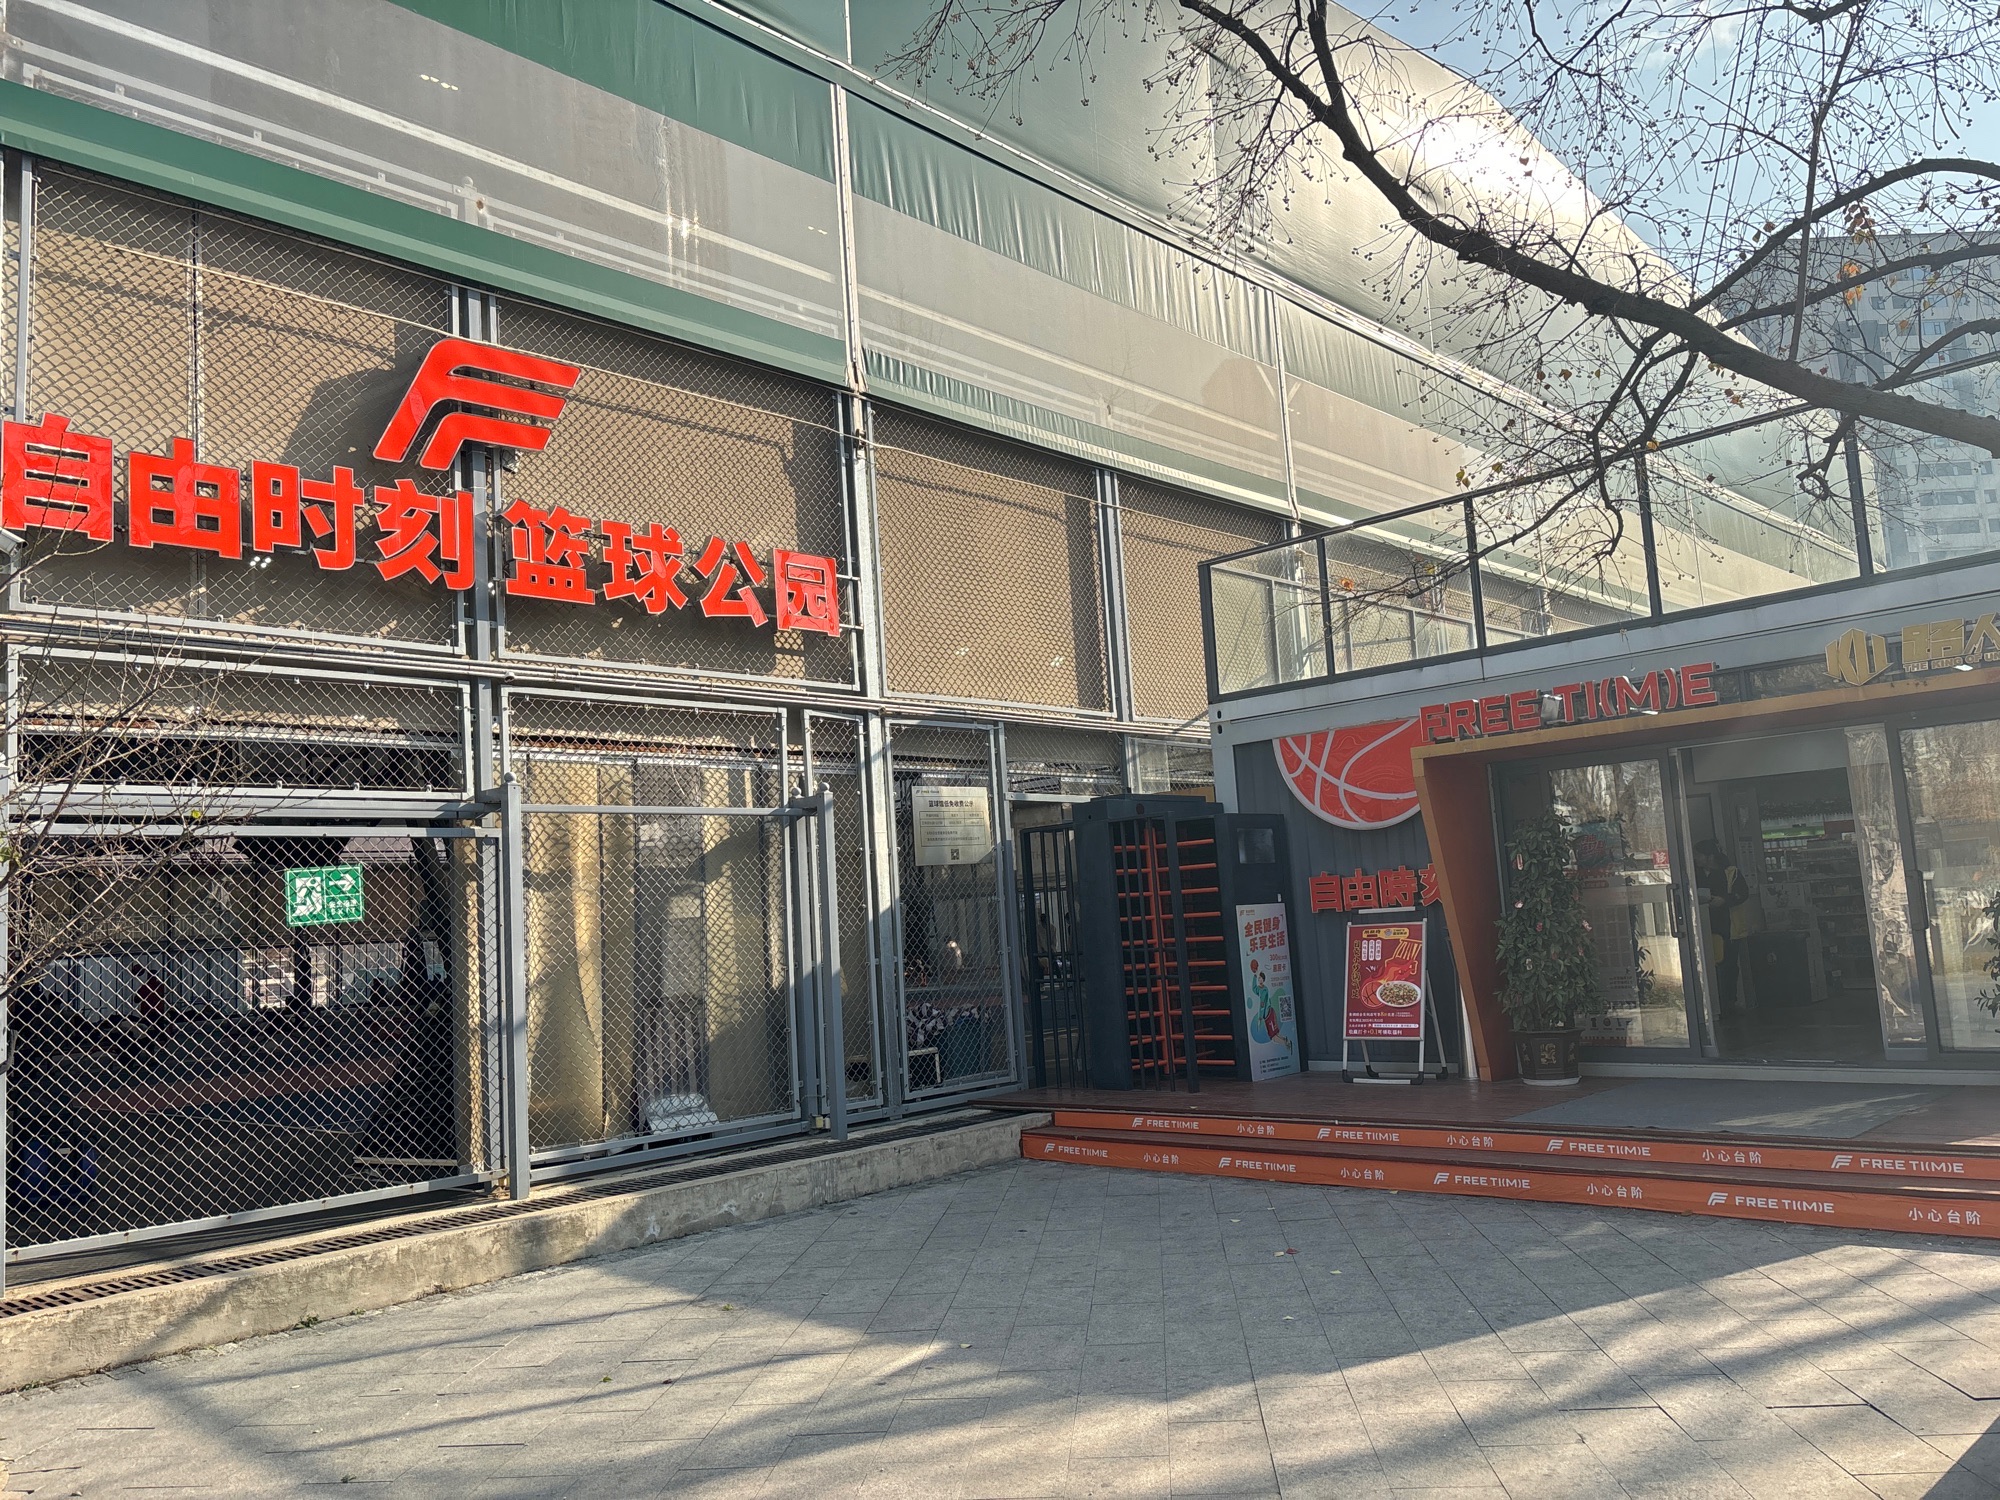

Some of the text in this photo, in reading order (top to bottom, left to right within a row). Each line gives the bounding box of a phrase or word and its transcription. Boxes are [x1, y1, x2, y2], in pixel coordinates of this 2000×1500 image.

[0, 412, 841, 637] 自由时刻 篮球公园
[1903, 661, 1928, 672] THE
[1931, 657, 1963, 669] KING
[1965, 652, 1982, 663] OF
[1420, 662, 1718, 742] FREE TI(M)E
[1244, 916, 1281, 938] 全民健身
[1249, 931, 1286, 953] 乐享生活
[1147, 1119, 1169, 1129] FREE
[1237, 1123, 1275, 1136] 小心台阶
[1335, 1130, 1363, 1140] FREE
[1447, 1135, 1494, 1148] 小心台阶
[1058, 1145, 1080, 1155] FREE
[1569, 1142, 1605, 1154] FREE
[1143, 1153, 1179, 1165] 小心台阶
[1702, 1149, 1762, 1164] 小心台阶
[1235, 1160, 1262, 1170] FREE
[1860, 1158, 1906, 1170] FREE
[1340, 1167, 1384, 1181] 小心台阶
[1455, 1175, 1488, 1186] FREE
[1587, 1184, 1643, 1199] 小心台阶
[1735, 1196, 1778, 1209] FREE
[1908, 1207, 1981, 1225] 小心台阶
